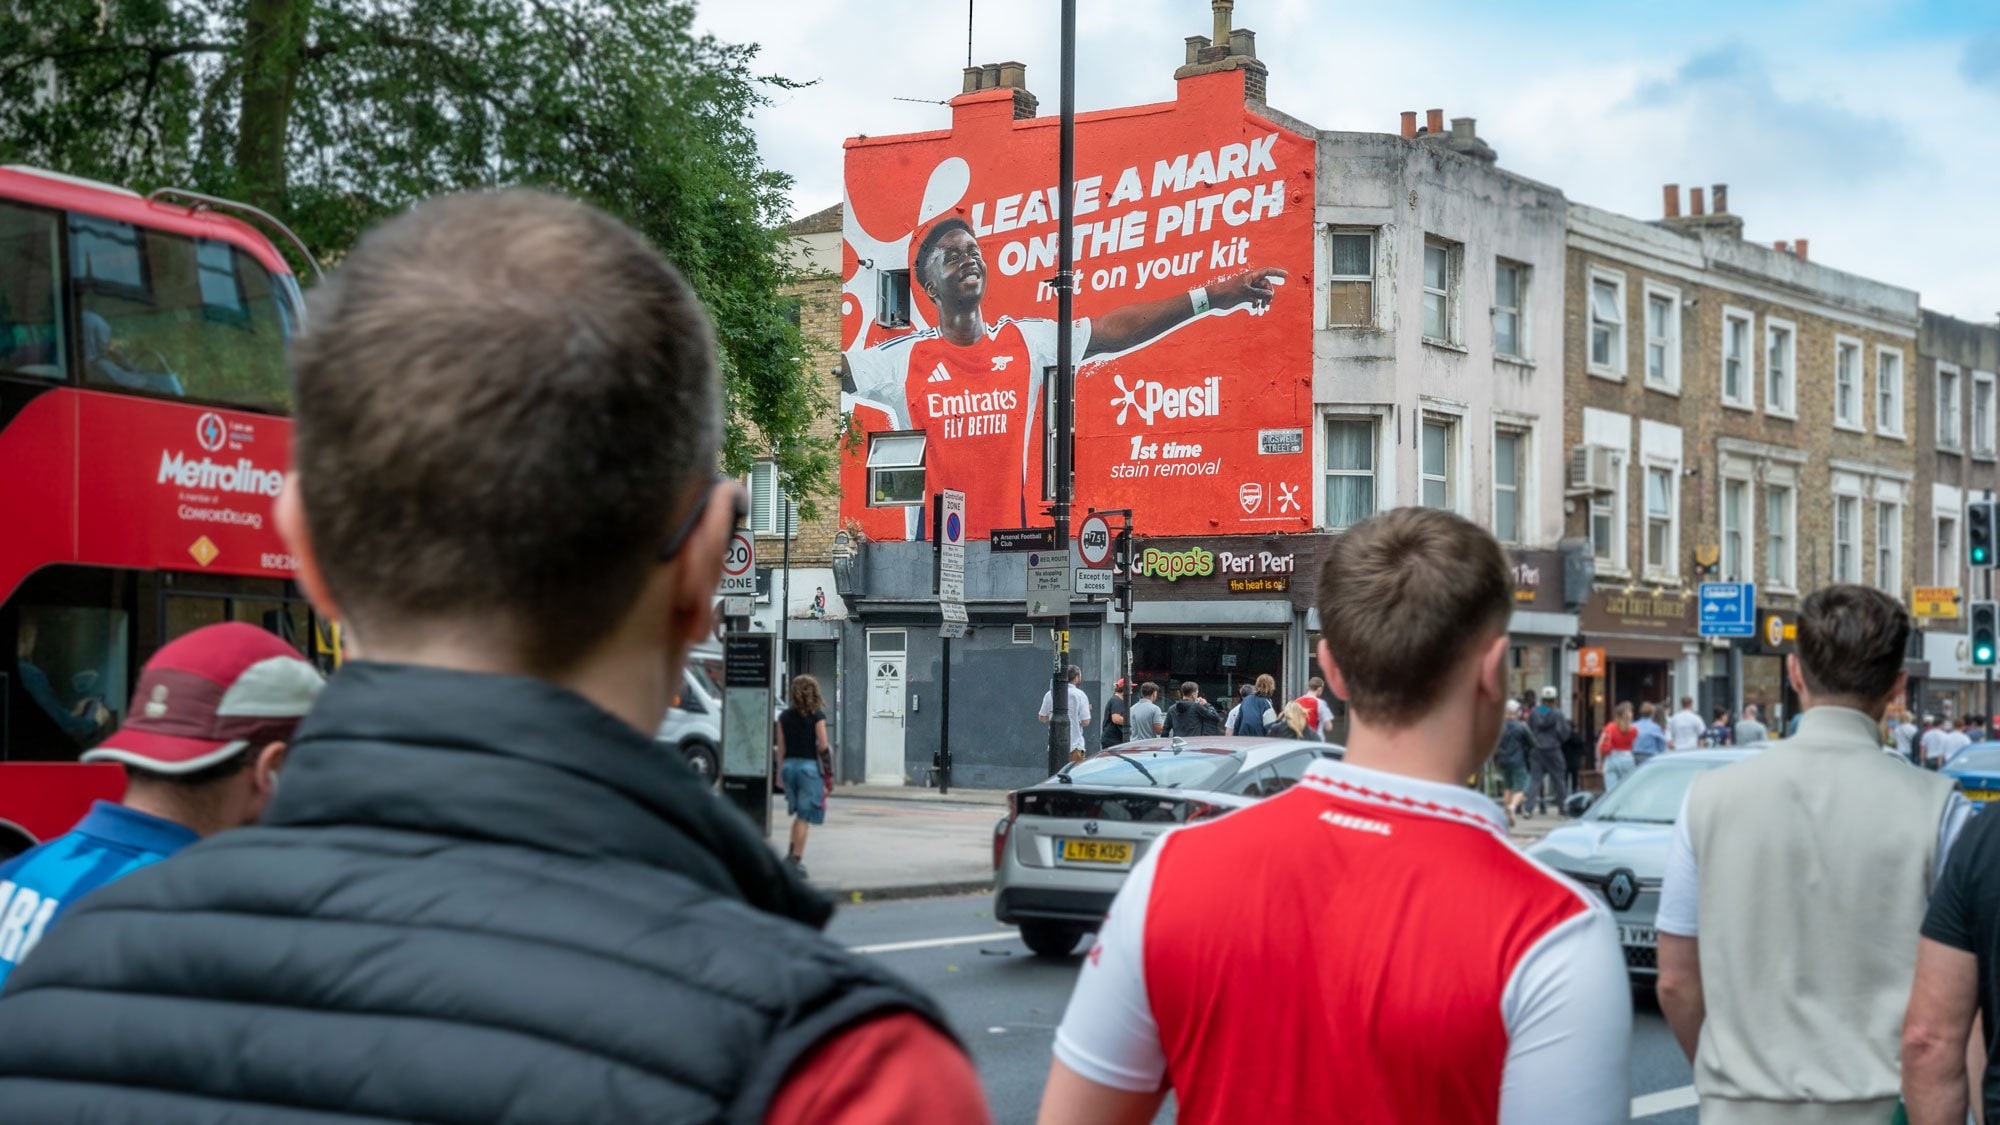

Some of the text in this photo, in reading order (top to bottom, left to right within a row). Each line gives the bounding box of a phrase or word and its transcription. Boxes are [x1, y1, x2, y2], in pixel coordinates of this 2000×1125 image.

[1108, 166, 1144, 208] A
[1150, 132, 1279, 197] MARK
[998, 179, 1285, 277] ON THE PITCH
[1036, 237, 1250, 302] nt on your kit
[927, 388, 1017, 418] Emirates
[1146, 376, 1220, 425] Persil
[944, 414, 1007, 440] FLY BETTER
[1130, 435, 1202, 461] 1st time
[1263, 433, 1299, 443] DIGSWELL
[1263, 443, 1290, 452] STREET
[157, 448, 284, 497] Metroline
[1110, 457, 1222, 478] stain removal
[945, 491, 964, 502] Controlled
[947, 501, 961, 511] ZONE
[1000, 533, 1020, 541] Arsenal
[726, 546, 748, 564] 20
[1144, 547, 1213, 581] Papa's
[1219, 551, 1254, 574] Peri
[1258, 551, 1294, 574] Peri
[720, 578, 752, 589] ZONE
[1079, 572, 1111, 581] Except for
[1231, 580, 1244, 590] the
[1245, 580, 1263, 590] heat
[1265, 580, 1272, 589] is
[1320, 810, 1392, 836] ARSENAL
[1067, 840, 1126, 860] LT16 KUS
